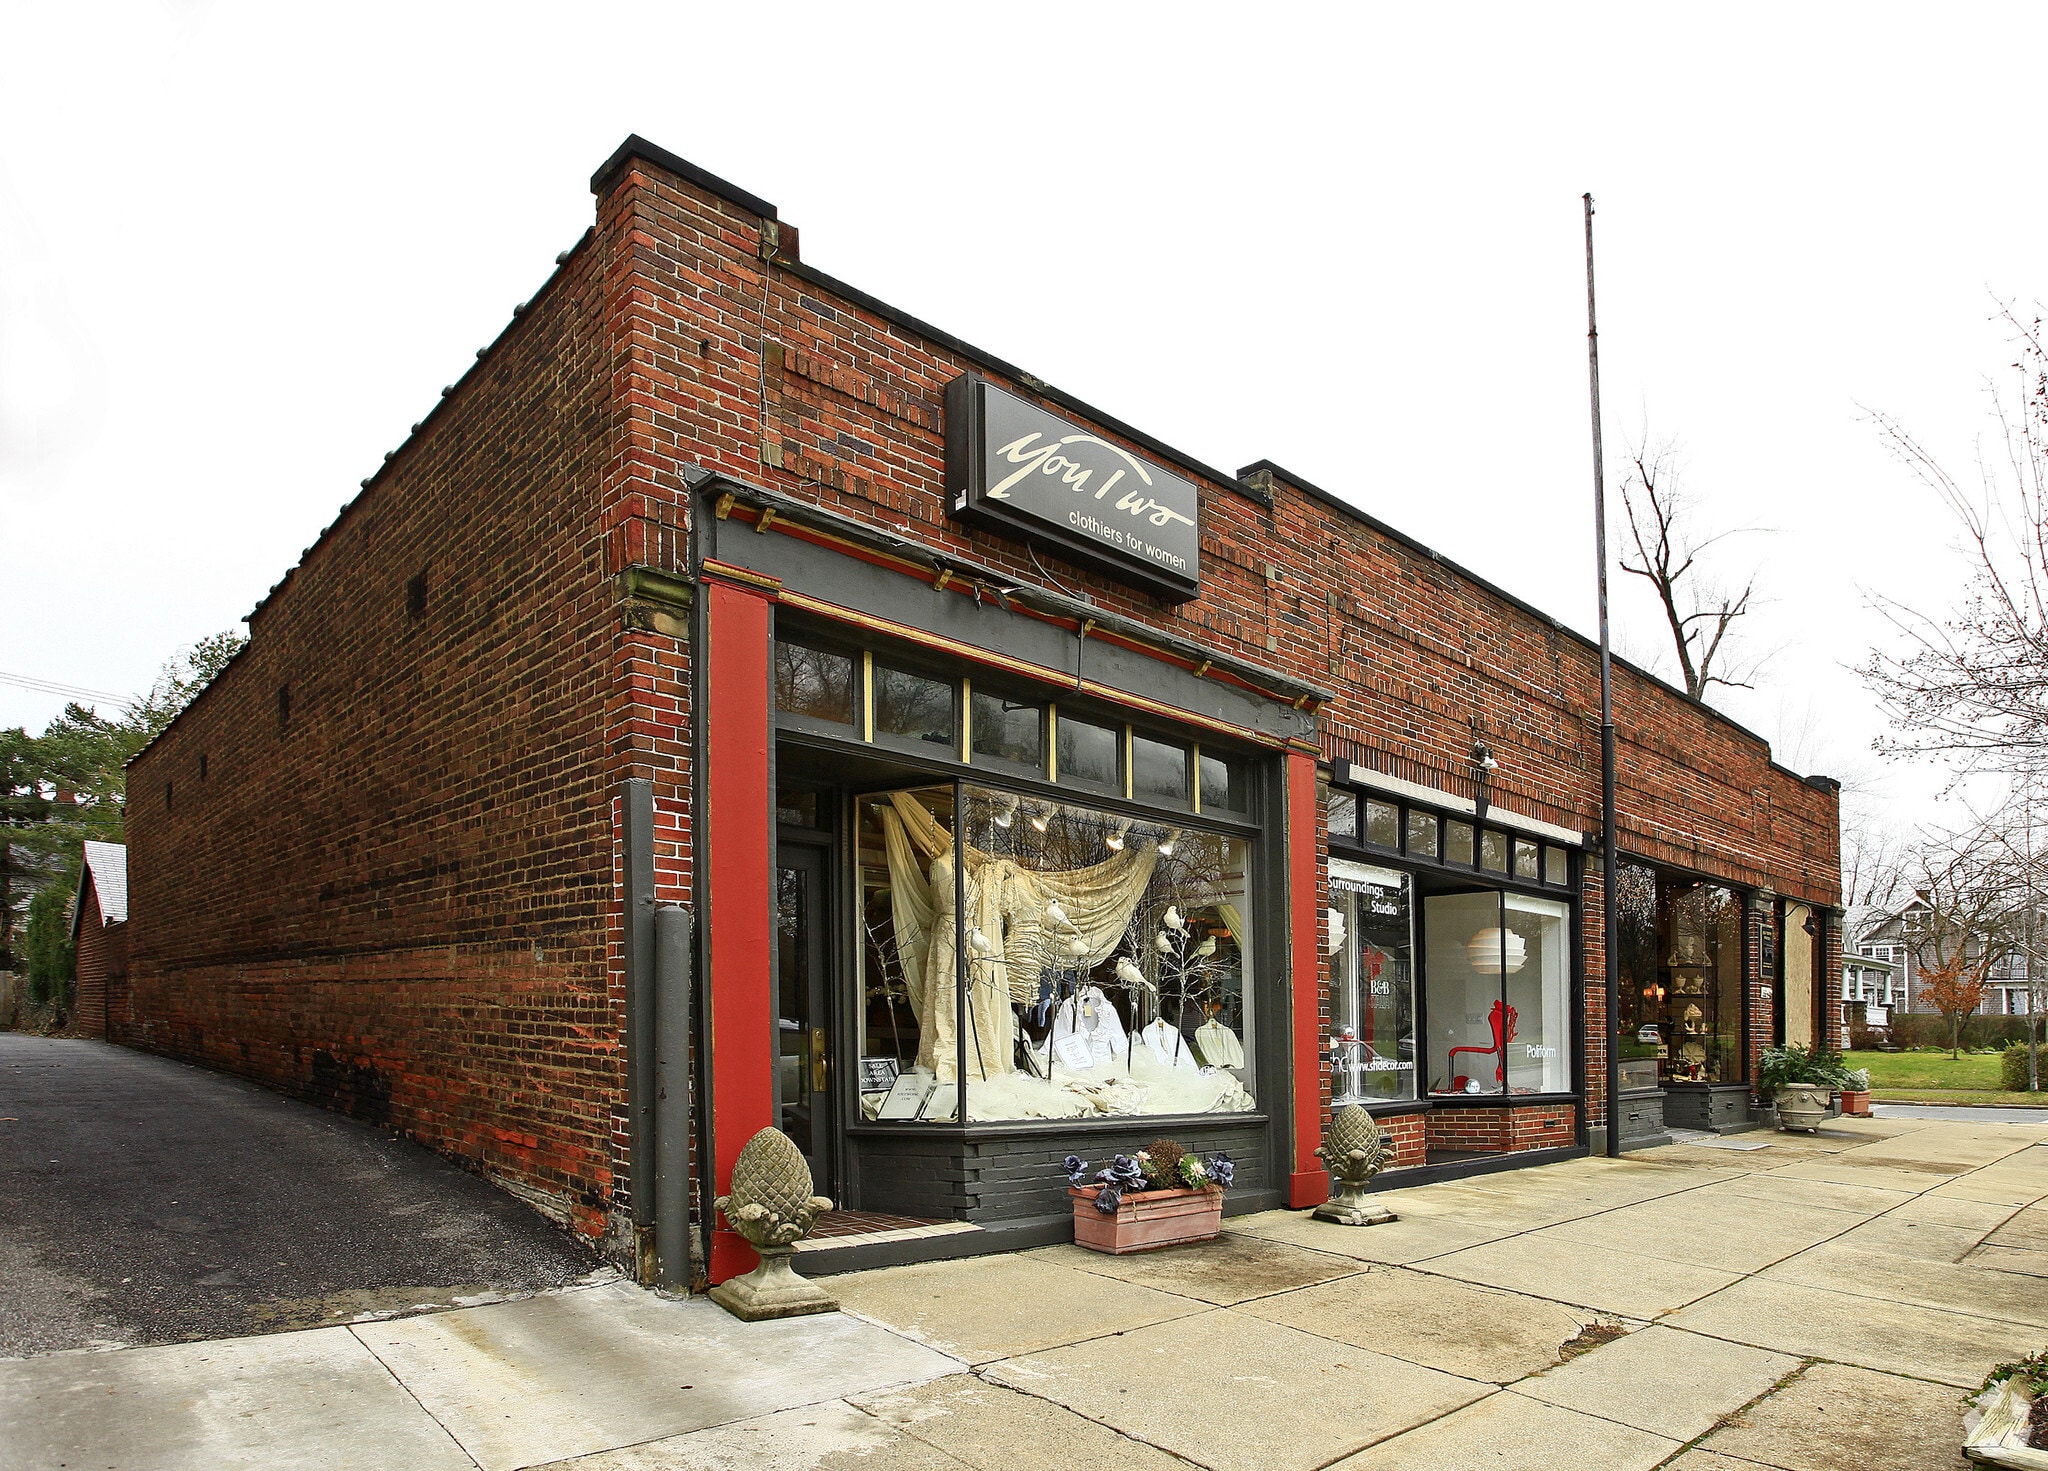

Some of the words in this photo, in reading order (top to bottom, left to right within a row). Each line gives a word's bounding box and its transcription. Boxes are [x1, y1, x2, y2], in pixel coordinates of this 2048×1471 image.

[1069, 511, 1122, 543] clothiers
[1126, 533, 1142, 551] for
[1145, 543, 1186, 570] women
[1328, 876, 1384, 899] Surroundings
[1371, 900, 1397, 916] Studio
